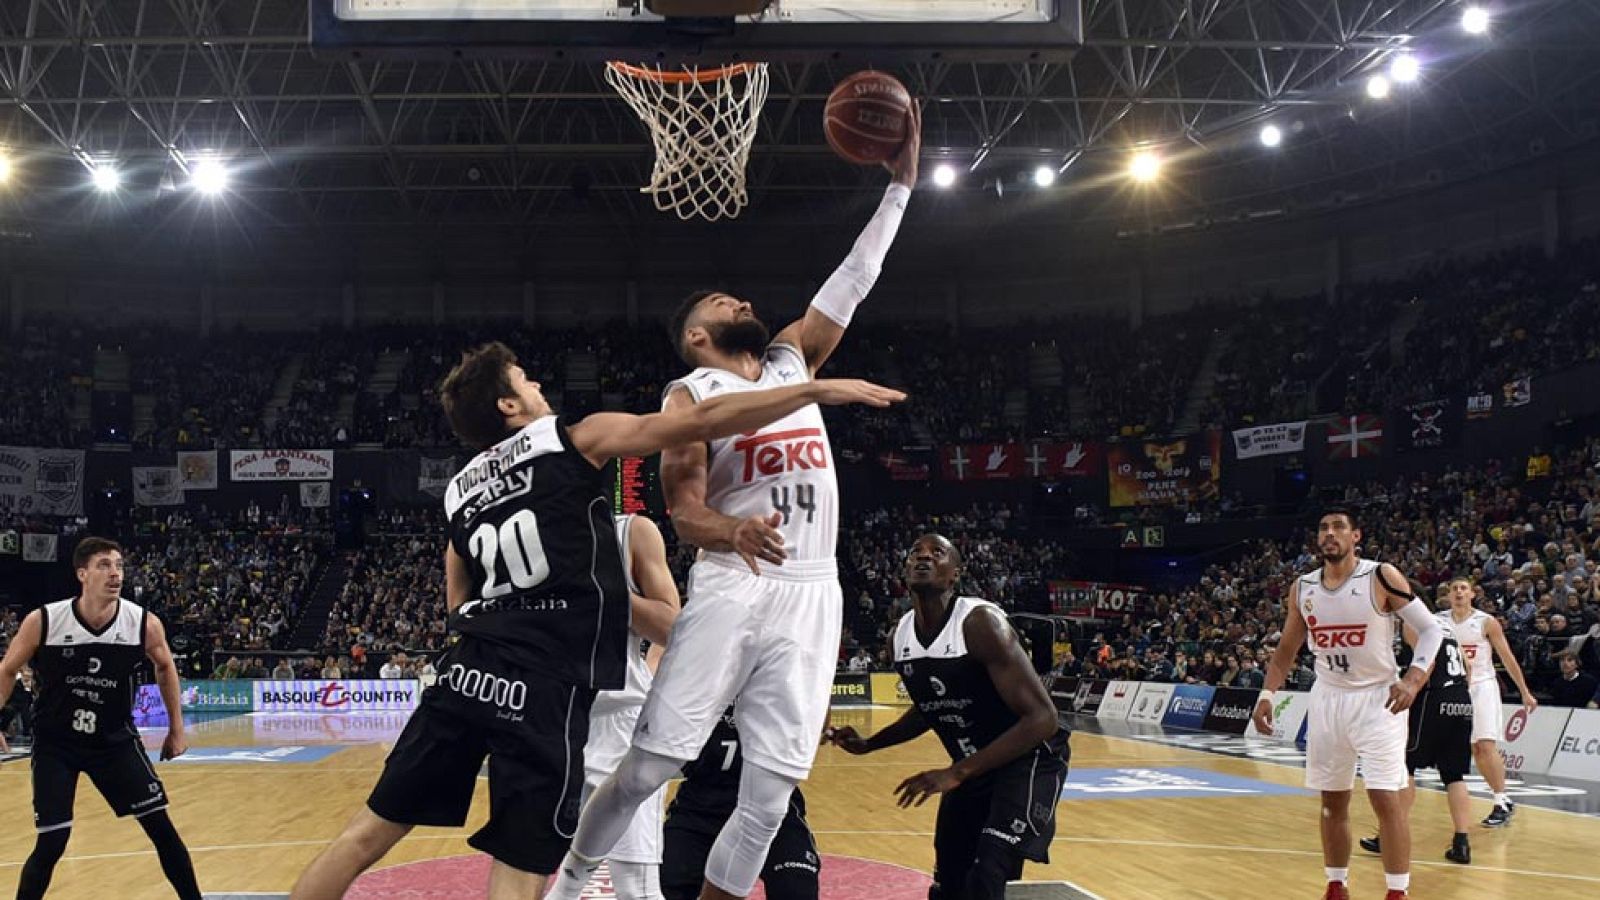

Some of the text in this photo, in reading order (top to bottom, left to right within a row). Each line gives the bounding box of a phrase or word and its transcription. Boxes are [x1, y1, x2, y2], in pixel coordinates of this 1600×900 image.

[735, 428, 827, 483] Teka
[770, 484, 816, 525] 44
[468, 508, 550, 599] 20
[1327, 655, 1349, 672] 14
[198, 692, 248, 705] Bizkaia
[262, 691, 322, 706] BASQUE
[72, 708, 97, 734] 33
[719, 740, 739, 771] 7
[1561, 735, 1582, 753] EL
